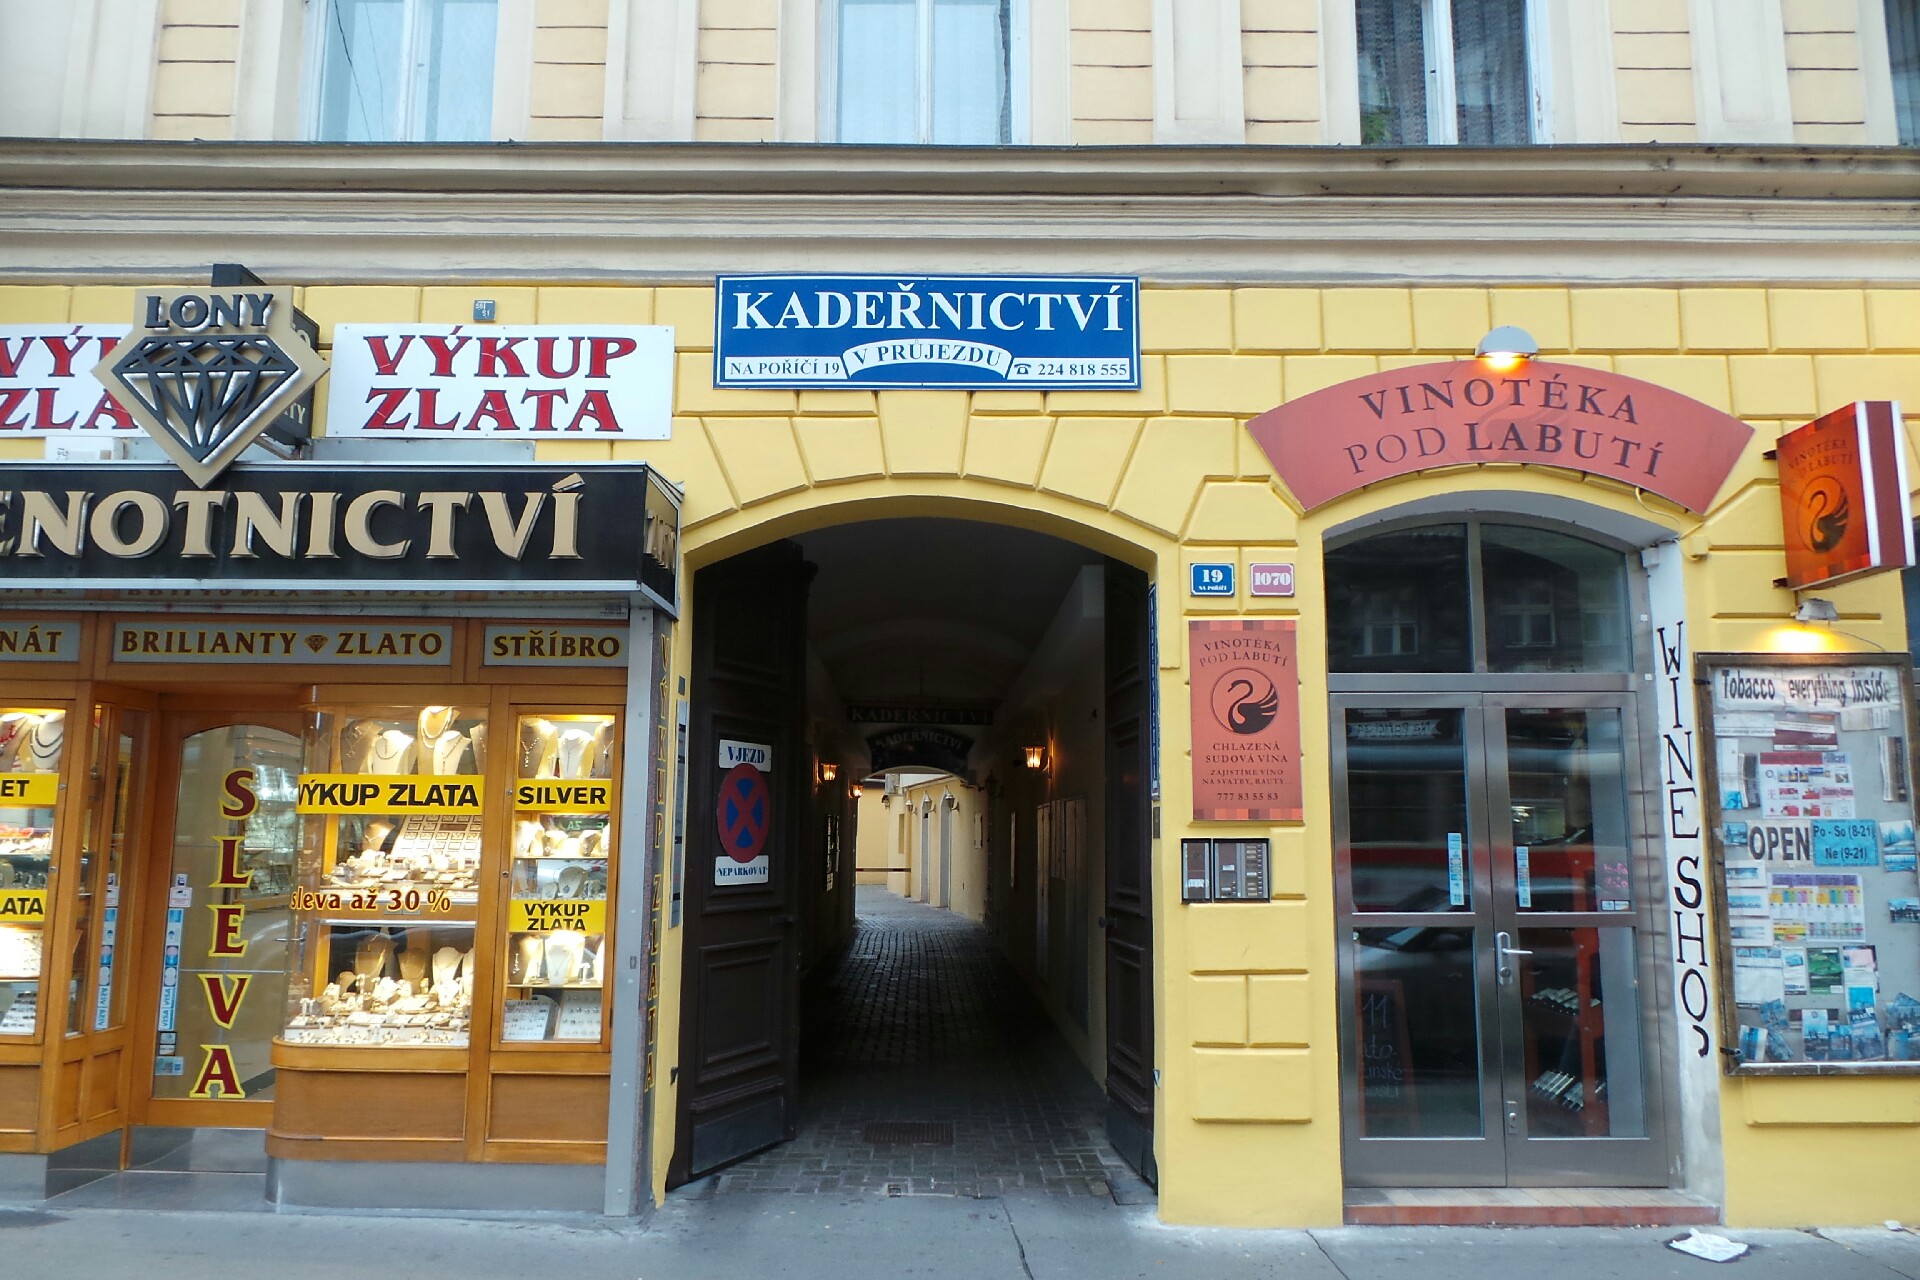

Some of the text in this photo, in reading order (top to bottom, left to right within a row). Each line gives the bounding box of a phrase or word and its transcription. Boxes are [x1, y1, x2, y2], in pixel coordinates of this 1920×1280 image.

[145, 293, 274, 330] LONY
[733, 282, 1124, 331] KADEŘNICTVÍ
[363, 326, 638, 379] VÝKUP
[852, 340, 1001, 368] V PRŮJEZDU
[729, 358, 840, 375] NA POŘÍČÍ 19
[1038, 363, 1127, 376] 224 818 555
[1359, 373, 1640, 425] VINOTÉKA
[362, 386, 624, 433] ZLATA
[1344, 423, 1664, 477] POD LABUTÍ
[1202, 569, 1223, 582] 19
[1254, 572, 1291, 586] 1070
[120, 630, 443, 656] BRILIANTY ZLATO
[492, 629, 621, 658] STŘÍBRO
[1204, 637, 1281, 652] VINOTÉKA
[1200, 651, 1288, 667] POD LABUTÍ
[1721, 669, 1776, 700] Tobacco
[1788, 672, 1847, 708] everything
[1657, 621, 1700, 839] WINE
[727, 746, 765, 764] VJEZD
[1213, 741, 1280, 751] CHLAZENÁ
[1206, 753, 1288, 763] SUDOVÁ VÍNA
[0, 780, 30, 797] ET
[298, 779, 479, 807] VÝKUP ZLATA
[517, 786, 606, 805] SILVER
[1217, 793, 1279, 801] 777 83 55 83
[1834, 825, 1846, 837] So
[1749, 826, 1810, 860] OPEN
[644, 633, 670, 1093] VÝKUP ZLATA
[1825, 847, 1868, 862] Ne (9-21)
[717, 866, 767, 877] NEPARKOVAT
[290, 886, 451, 912] sleva až 30 %
[524, 901, 590, 917] VÝKUP
[189, 768, 259, 1099] SLEVA
[527, 918, 586, 931] ZLATA
[161, 1010, 169, 1027] VISA
